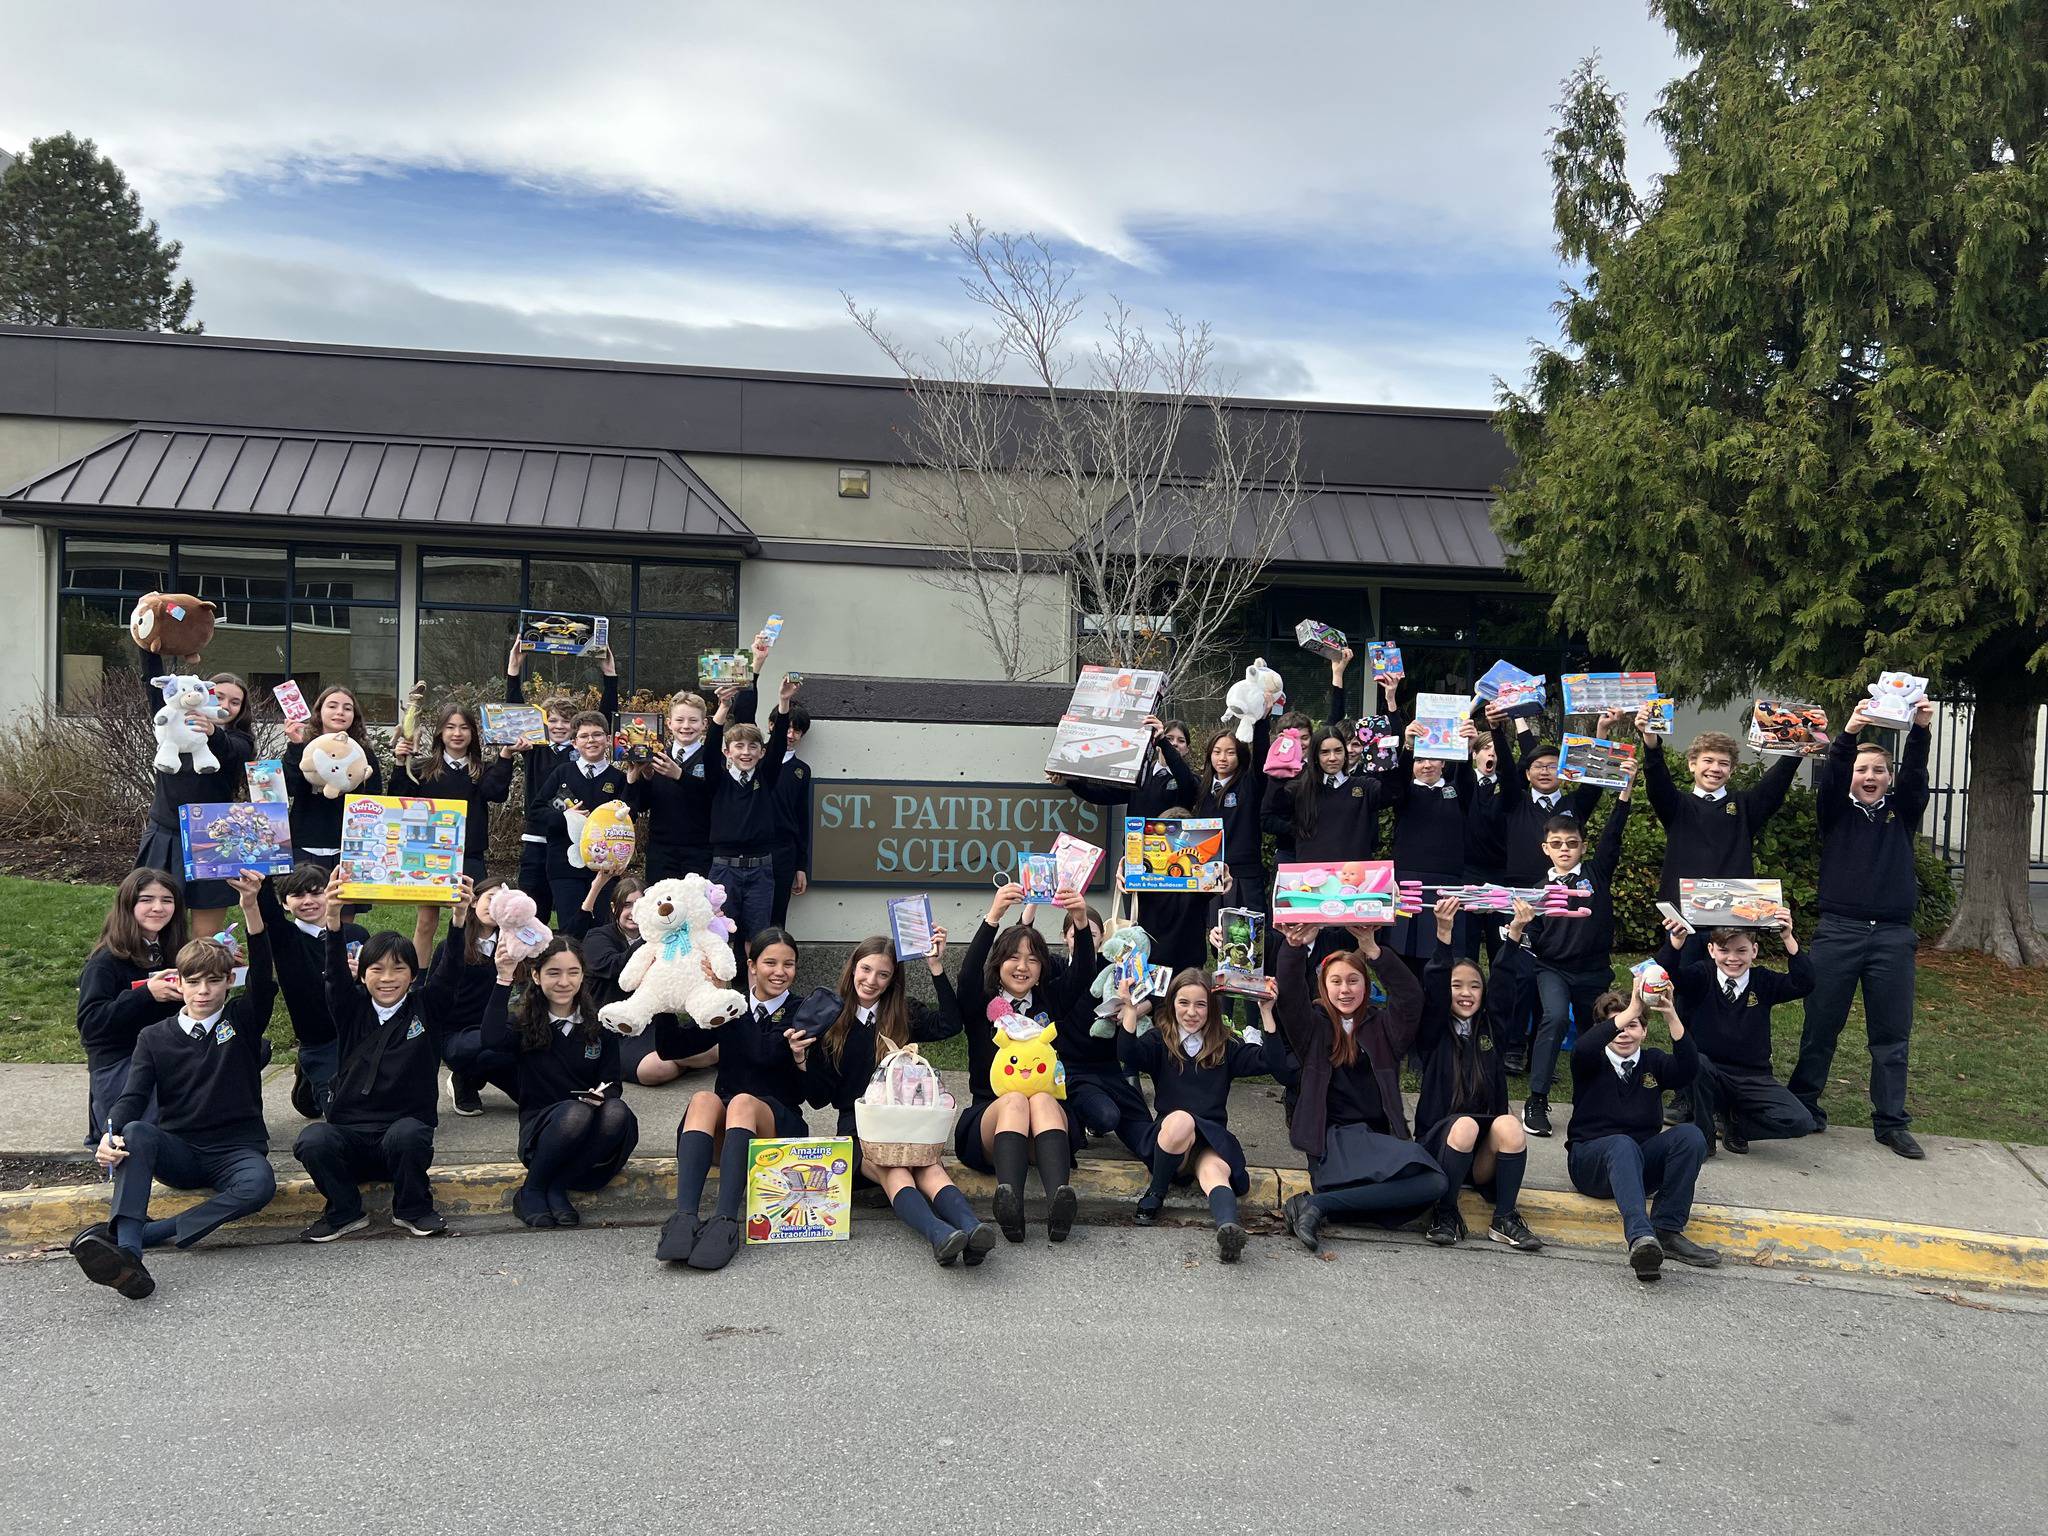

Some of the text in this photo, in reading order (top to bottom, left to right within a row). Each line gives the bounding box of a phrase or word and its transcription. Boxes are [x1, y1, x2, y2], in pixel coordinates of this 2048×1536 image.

[820, 794, 1100, 833] ST. PATRICK'S
[790, 1145, 832, 1156] Amazing
[771, 1229, 833, 1239] extraordinaire
